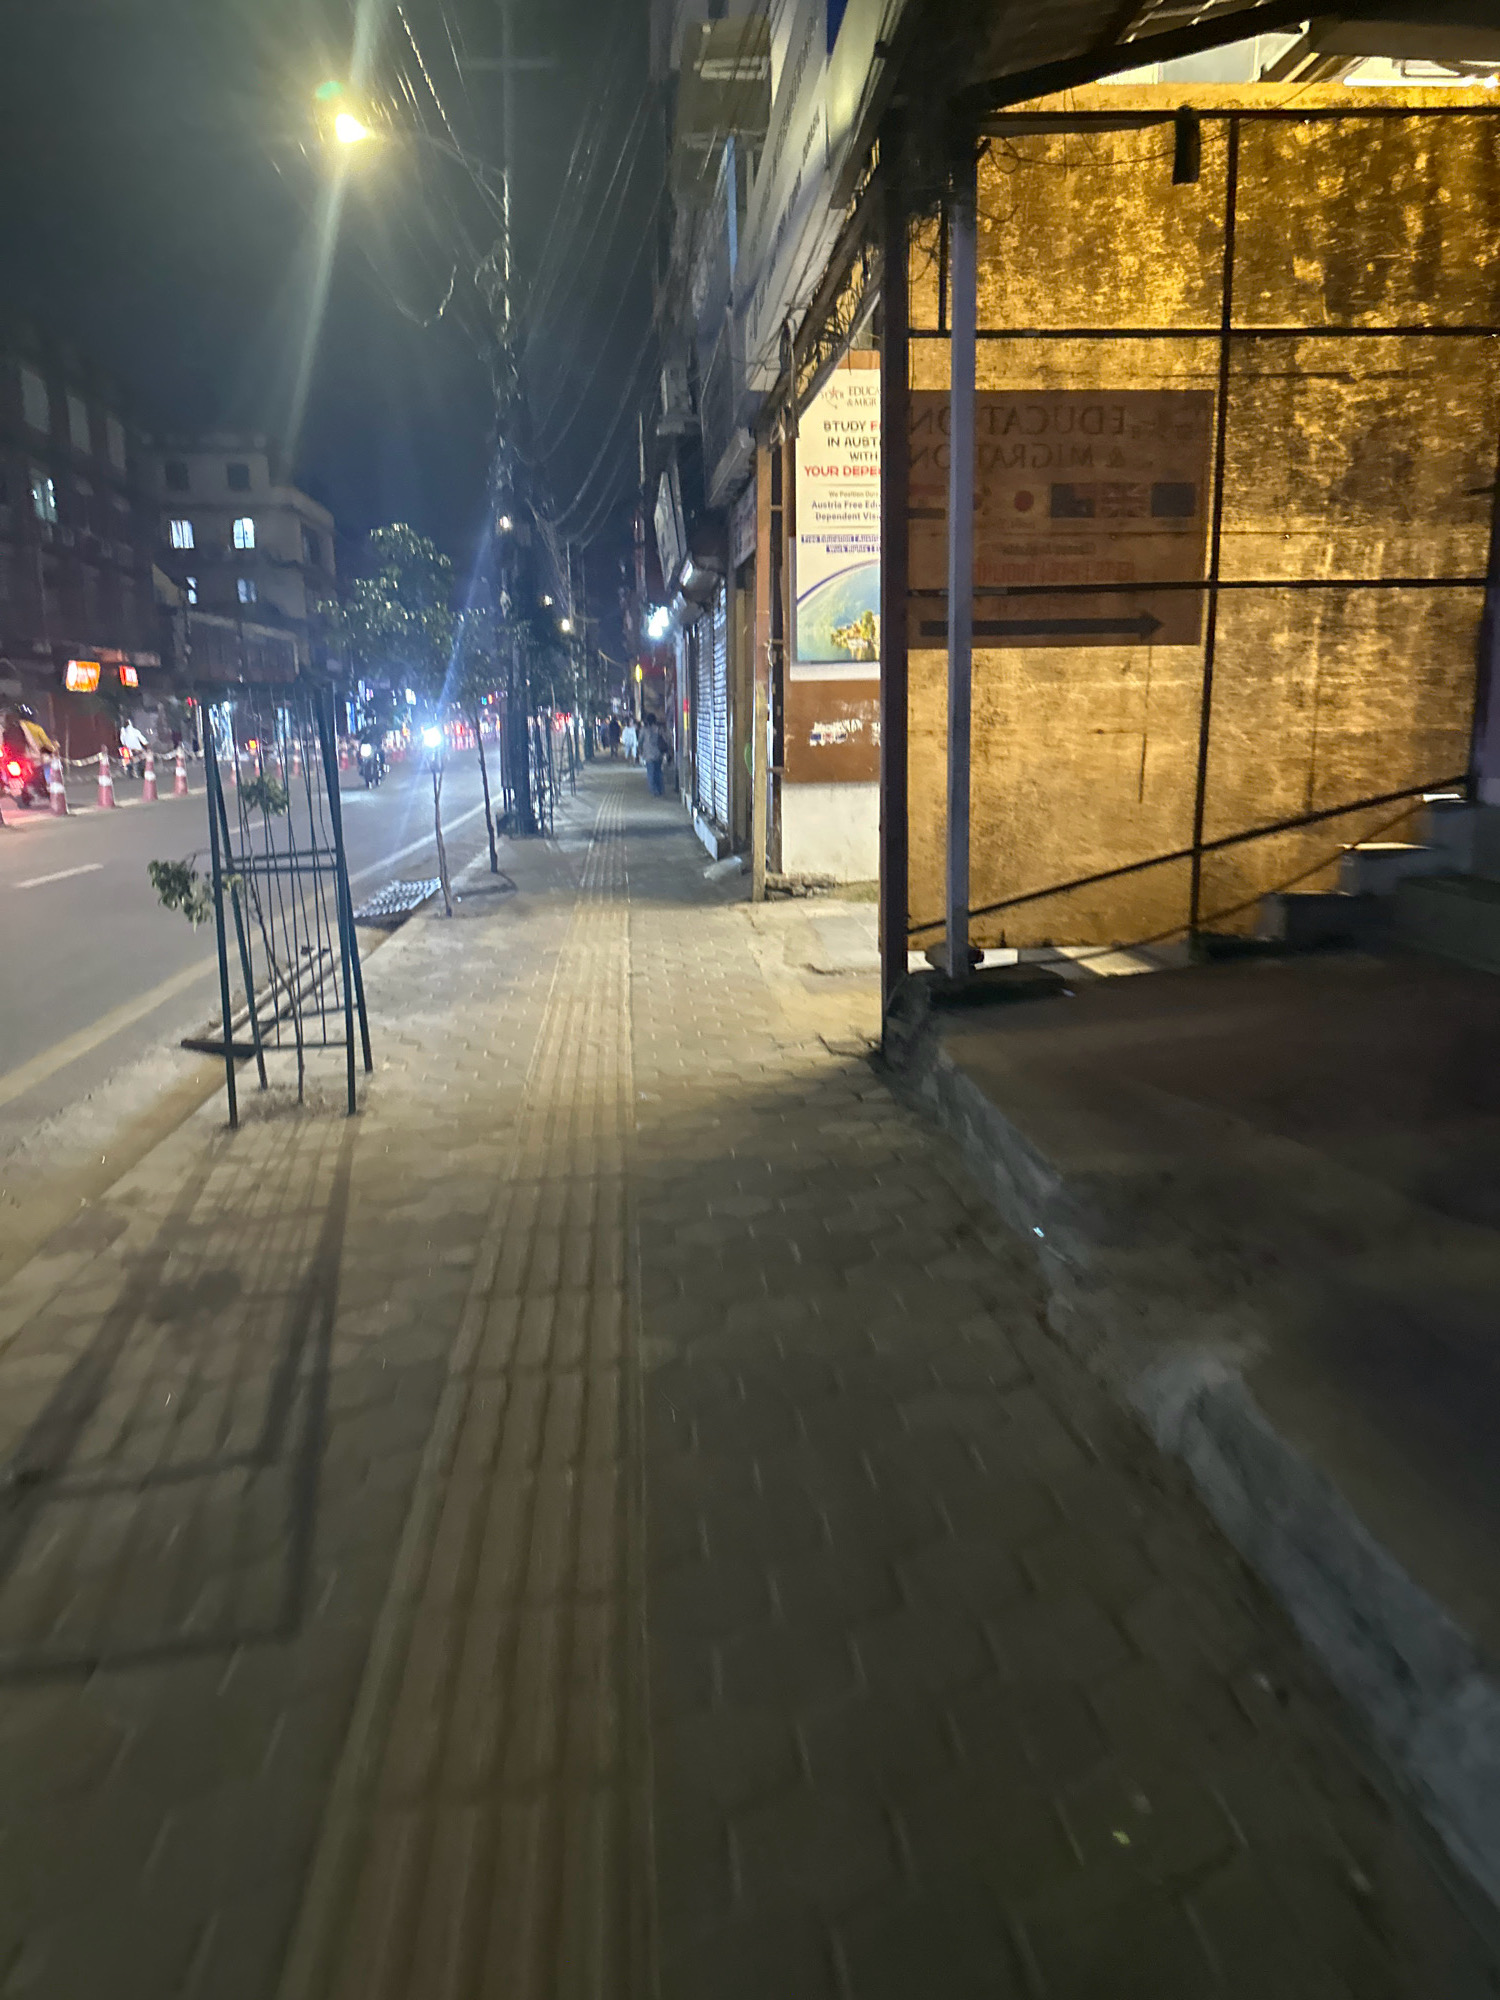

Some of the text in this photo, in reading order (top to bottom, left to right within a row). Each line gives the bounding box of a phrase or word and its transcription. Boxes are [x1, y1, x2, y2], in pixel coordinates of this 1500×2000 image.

[824, 421, 881, 432] STUDY F
[827, 437, 880, 447] IN AUST
[850, 451, 878, 461] WITH
[804, 466, 839, 476] YOUR
[812, 500, 842, 509] Austria
[845, 500, 863, 509] Free
[815, 512, 860, 522] Dependent
